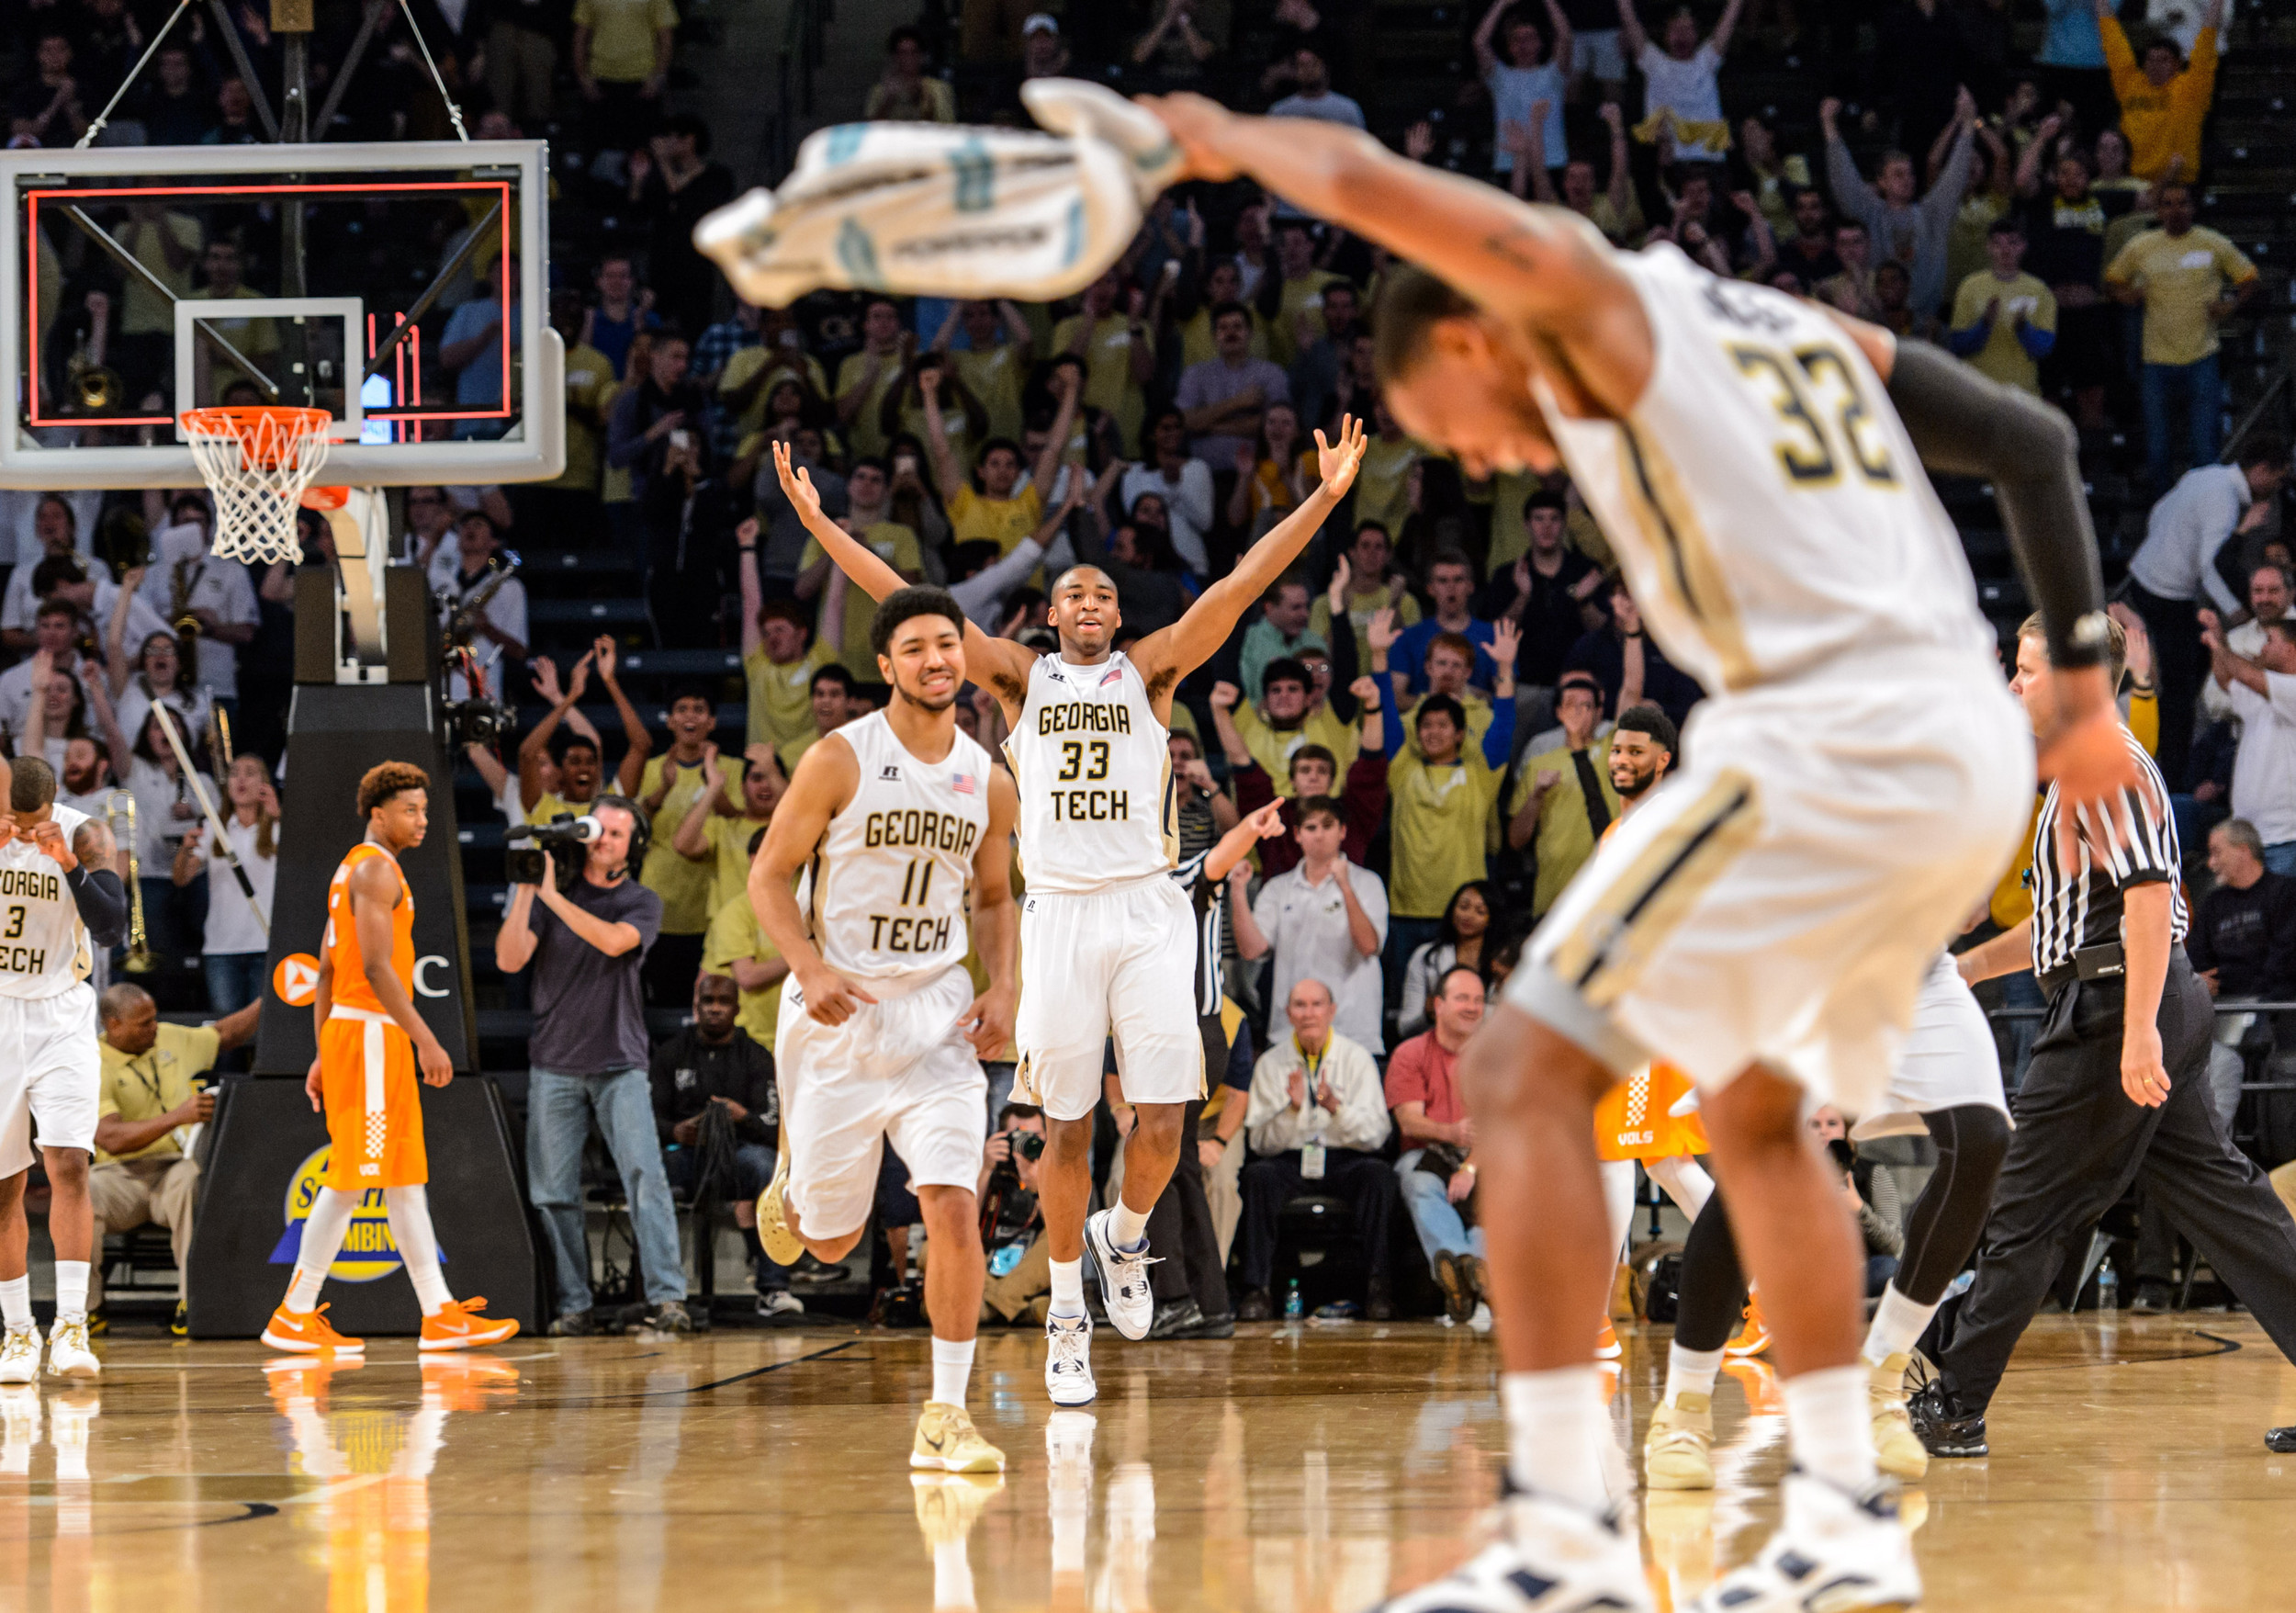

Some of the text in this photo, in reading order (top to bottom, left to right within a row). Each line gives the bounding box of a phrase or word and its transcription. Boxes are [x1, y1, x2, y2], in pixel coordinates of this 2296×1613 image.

[1722, 340, 1905, 491] 32
[1039, 702, 1131, 736] GEORGIA
[1058, 740, 1110, 782] 33
[1051, 790, 1128, 821] TECH
[865, 809, 978, 859] GEORGIA
[0, 869, 59, 901] ORGIA
[899, 857, 935, 907] 11
[4, 905, 27, 939] 3
[870, 915, 951, 953] TECH
[1617, 1130, 1654, 1146] VOLS
